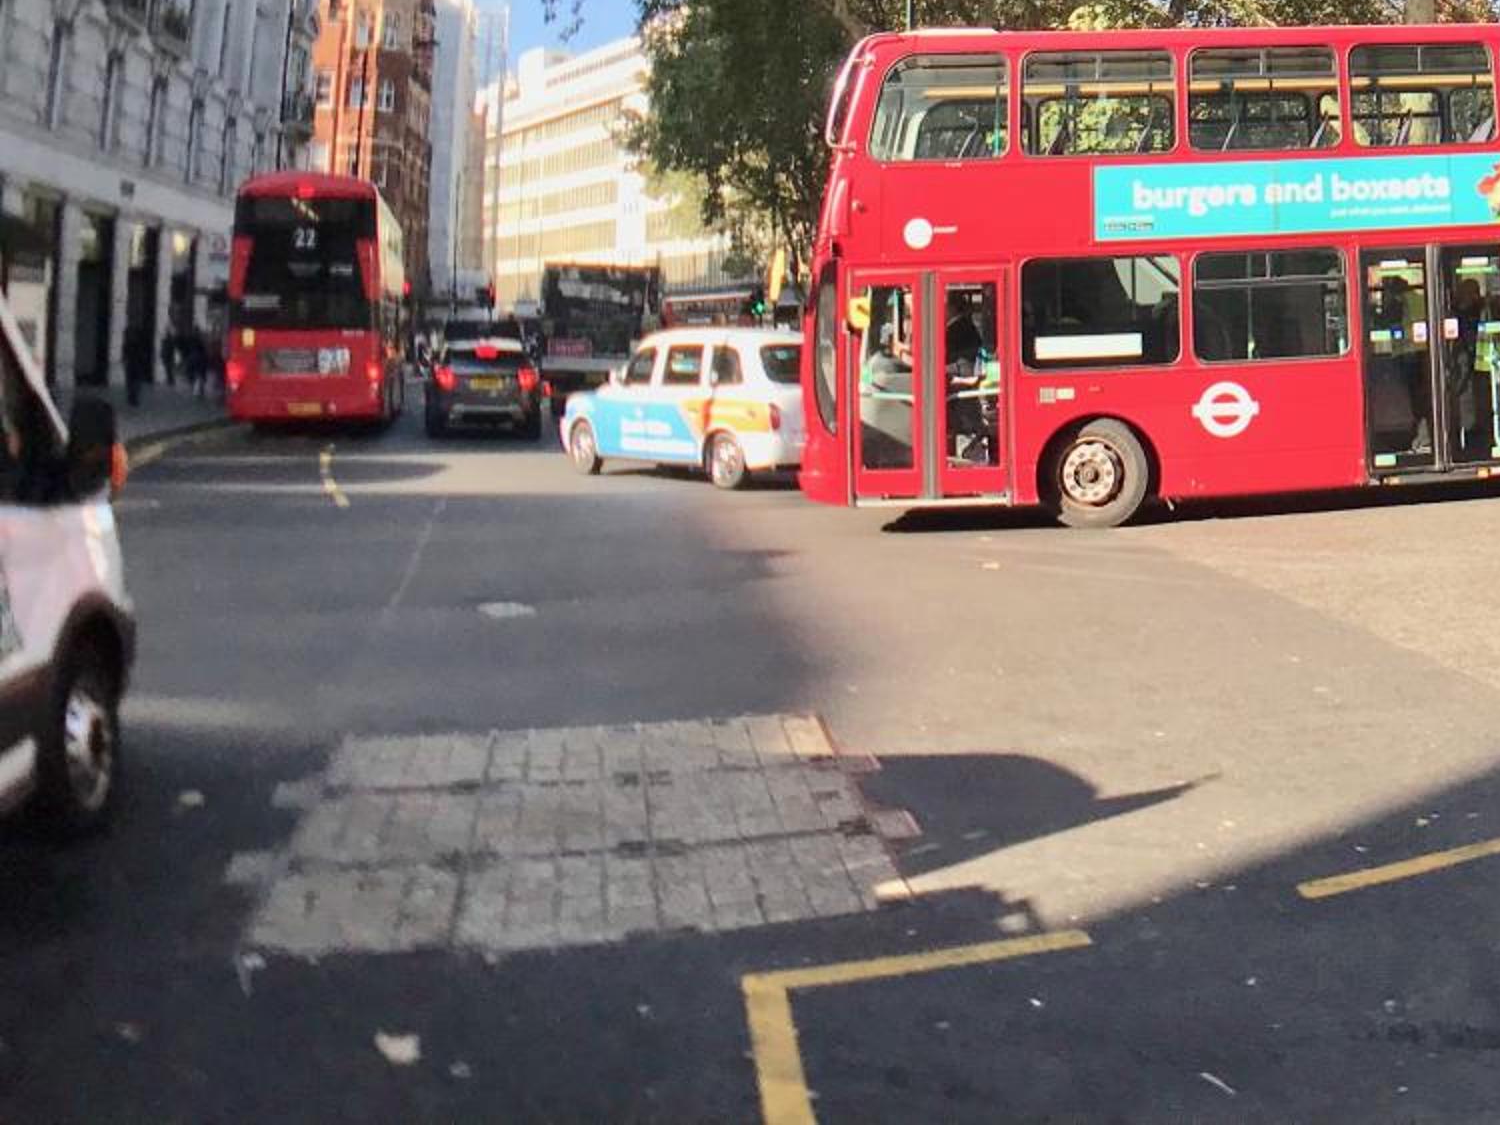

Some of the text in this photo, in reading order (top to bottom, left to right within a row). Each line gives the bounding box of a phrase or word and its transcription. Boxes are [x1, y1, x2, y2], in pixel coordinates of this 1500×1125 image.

[1132, 171, 1451, 216] burgers and boxsets
[293, 227, 317, 249] 22
